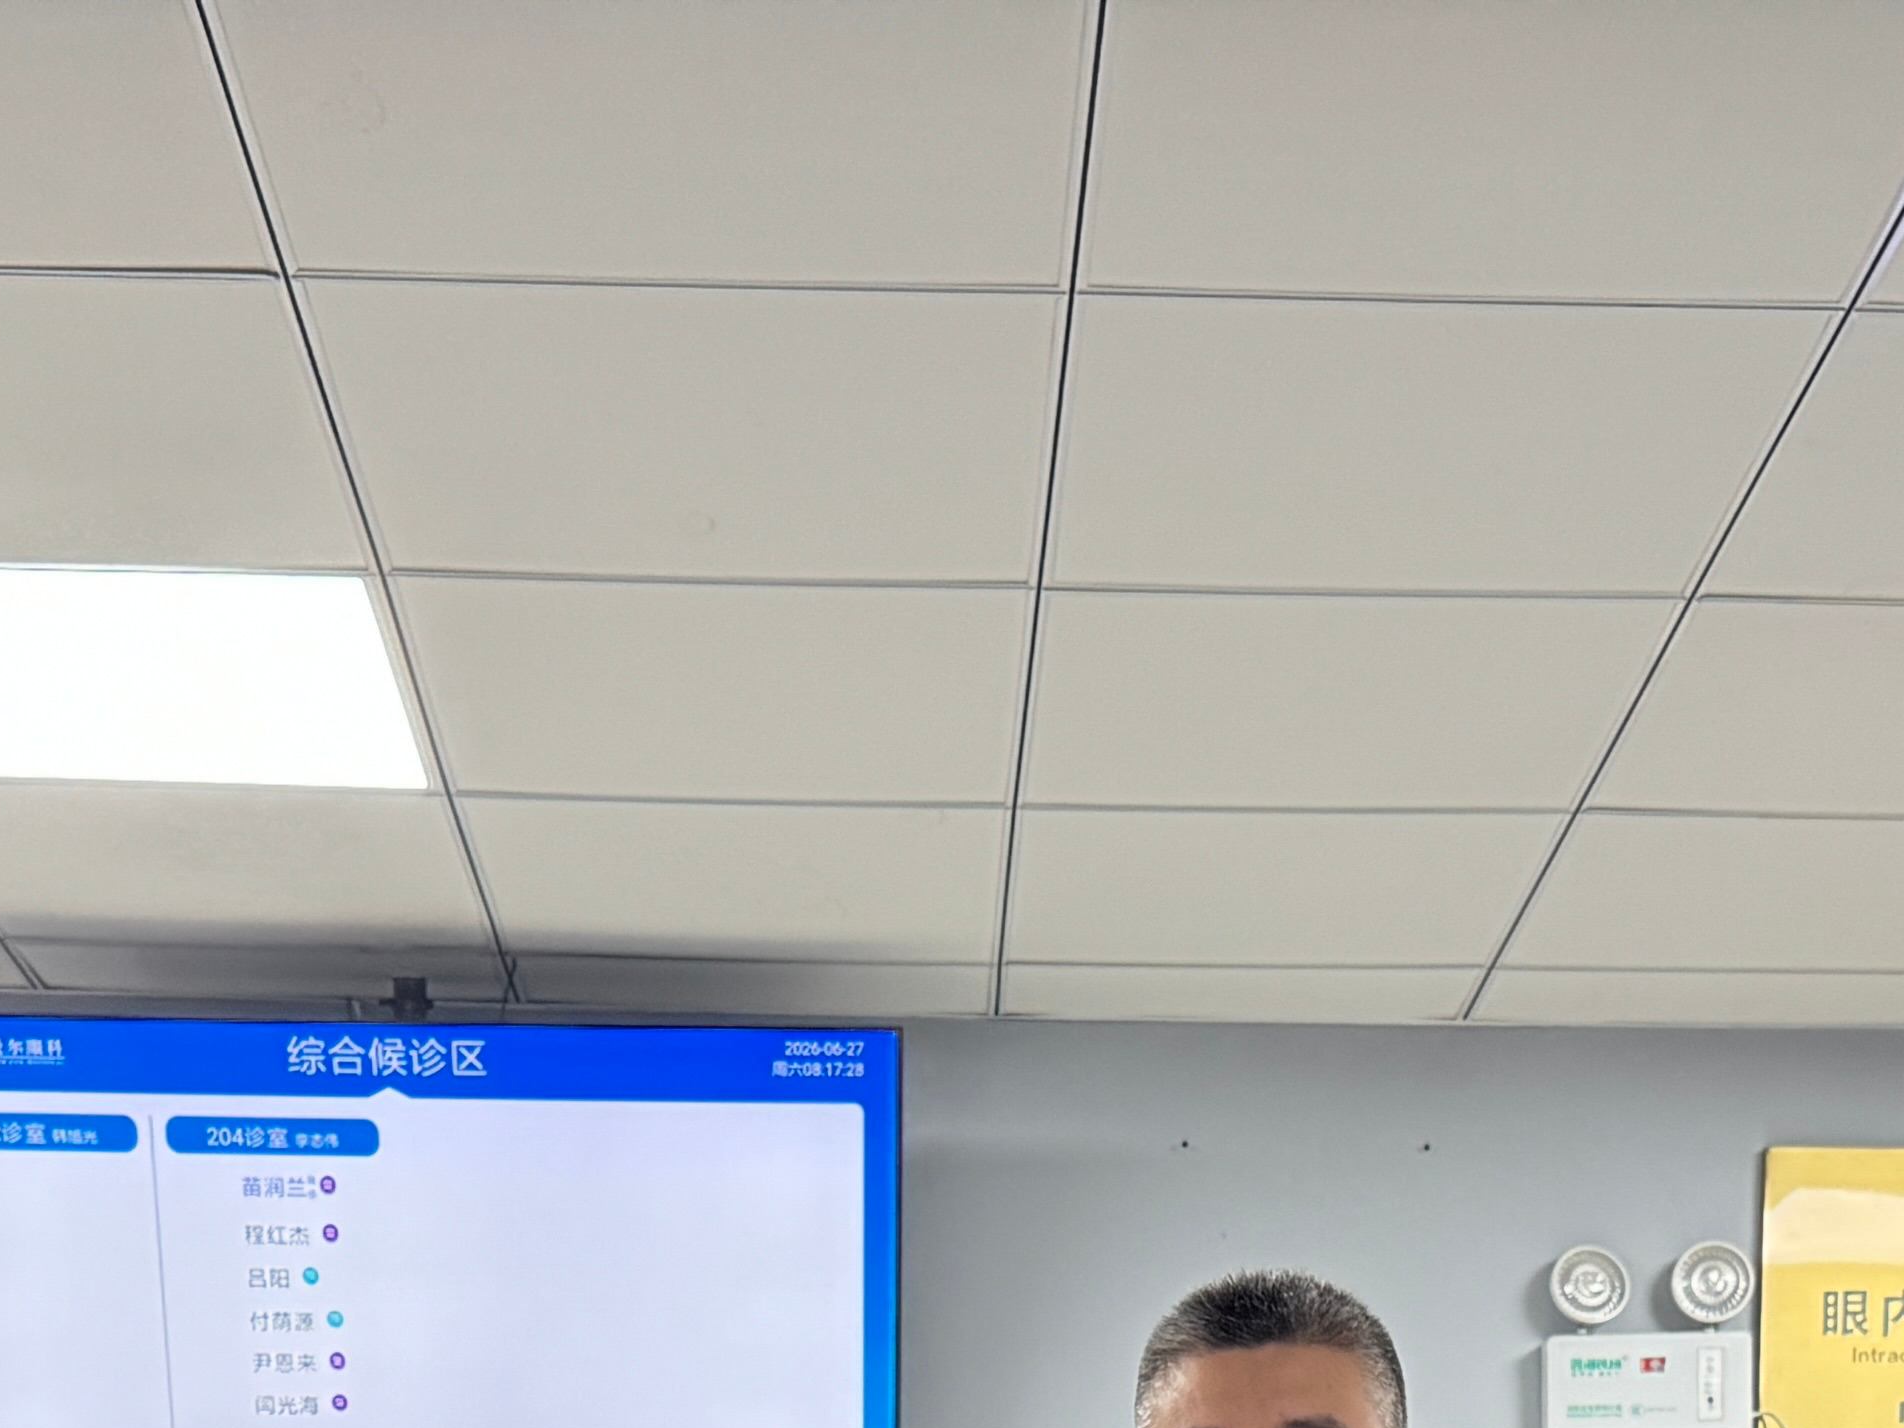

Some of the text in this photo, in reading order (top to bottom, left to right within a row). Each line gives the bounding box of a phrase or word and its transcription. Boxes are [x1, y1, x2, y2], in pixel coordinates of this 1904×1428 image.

[288, 1036, 487, 1077] 综合候诊区
[785, 1041, 864, 1057] 2026-06-27
[206, 1126, 289, 1150] 204诊室
[241, 1177, 307, 1199] 苗润兰
[245, 1226, 310, 1247] 程红杰
[249, 1269, 291, 1290] 吕阳
